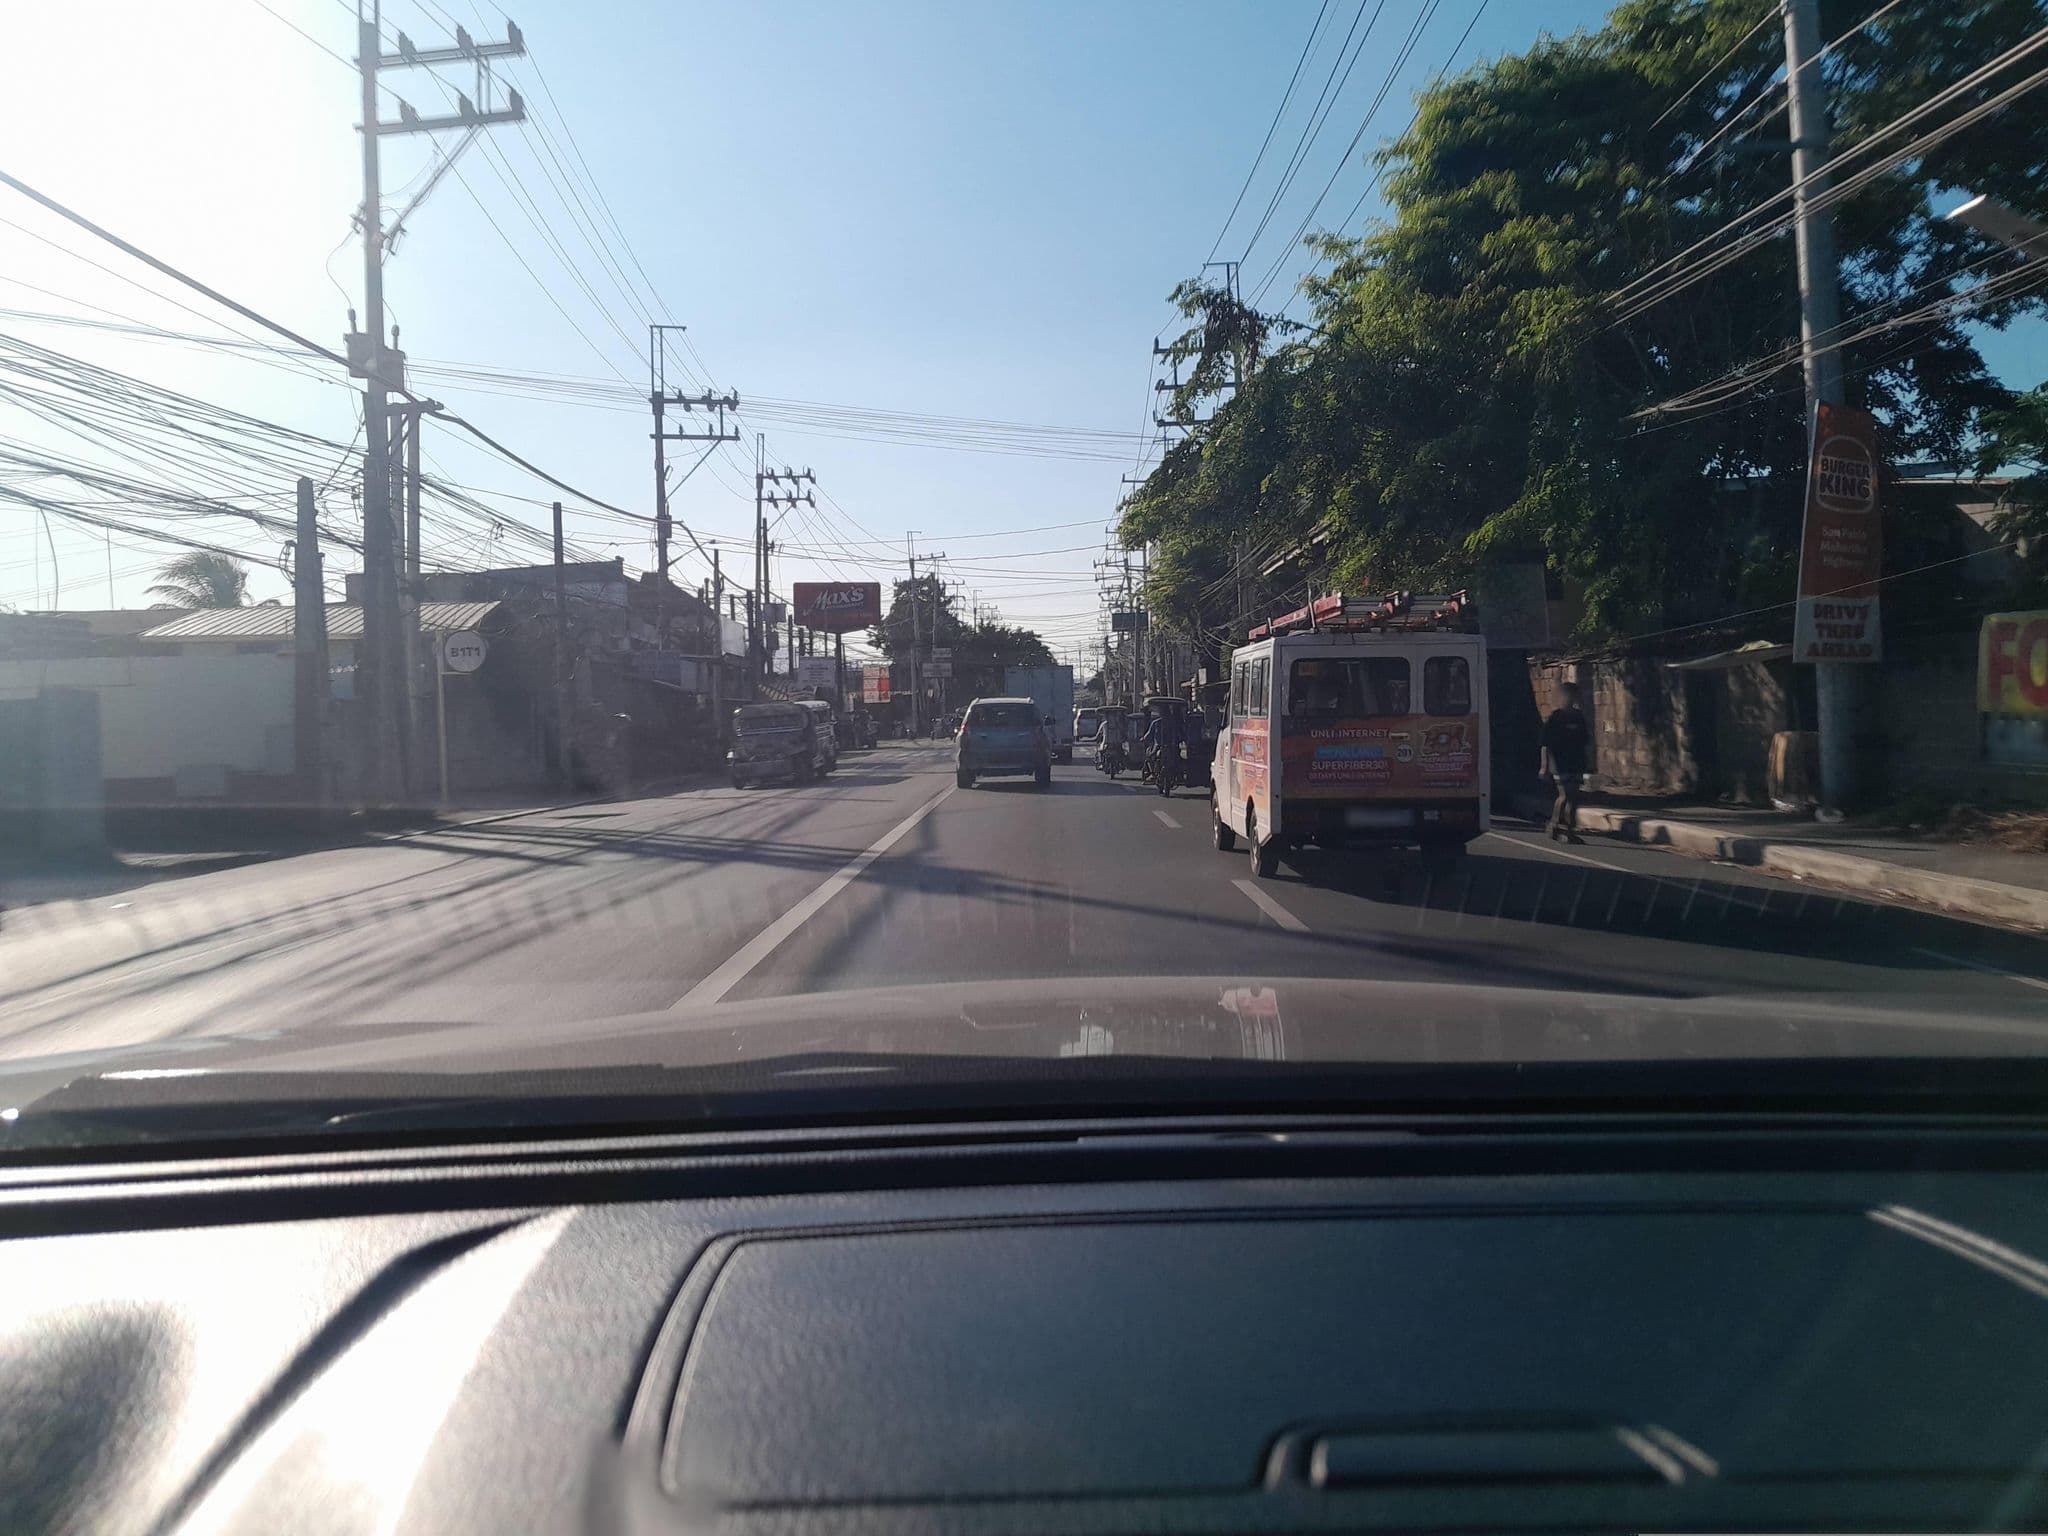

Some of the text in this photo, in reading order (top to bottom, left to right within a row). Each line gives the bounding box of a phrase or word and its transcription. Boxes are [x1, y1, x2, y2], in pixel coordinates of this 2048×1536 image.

[1821, 457, 1871, 478] BURGER
[1819, 473, 1871, 499] KING
[805, 585, 864, 612] Max's
[450, 646, 481, 658] B1T1
